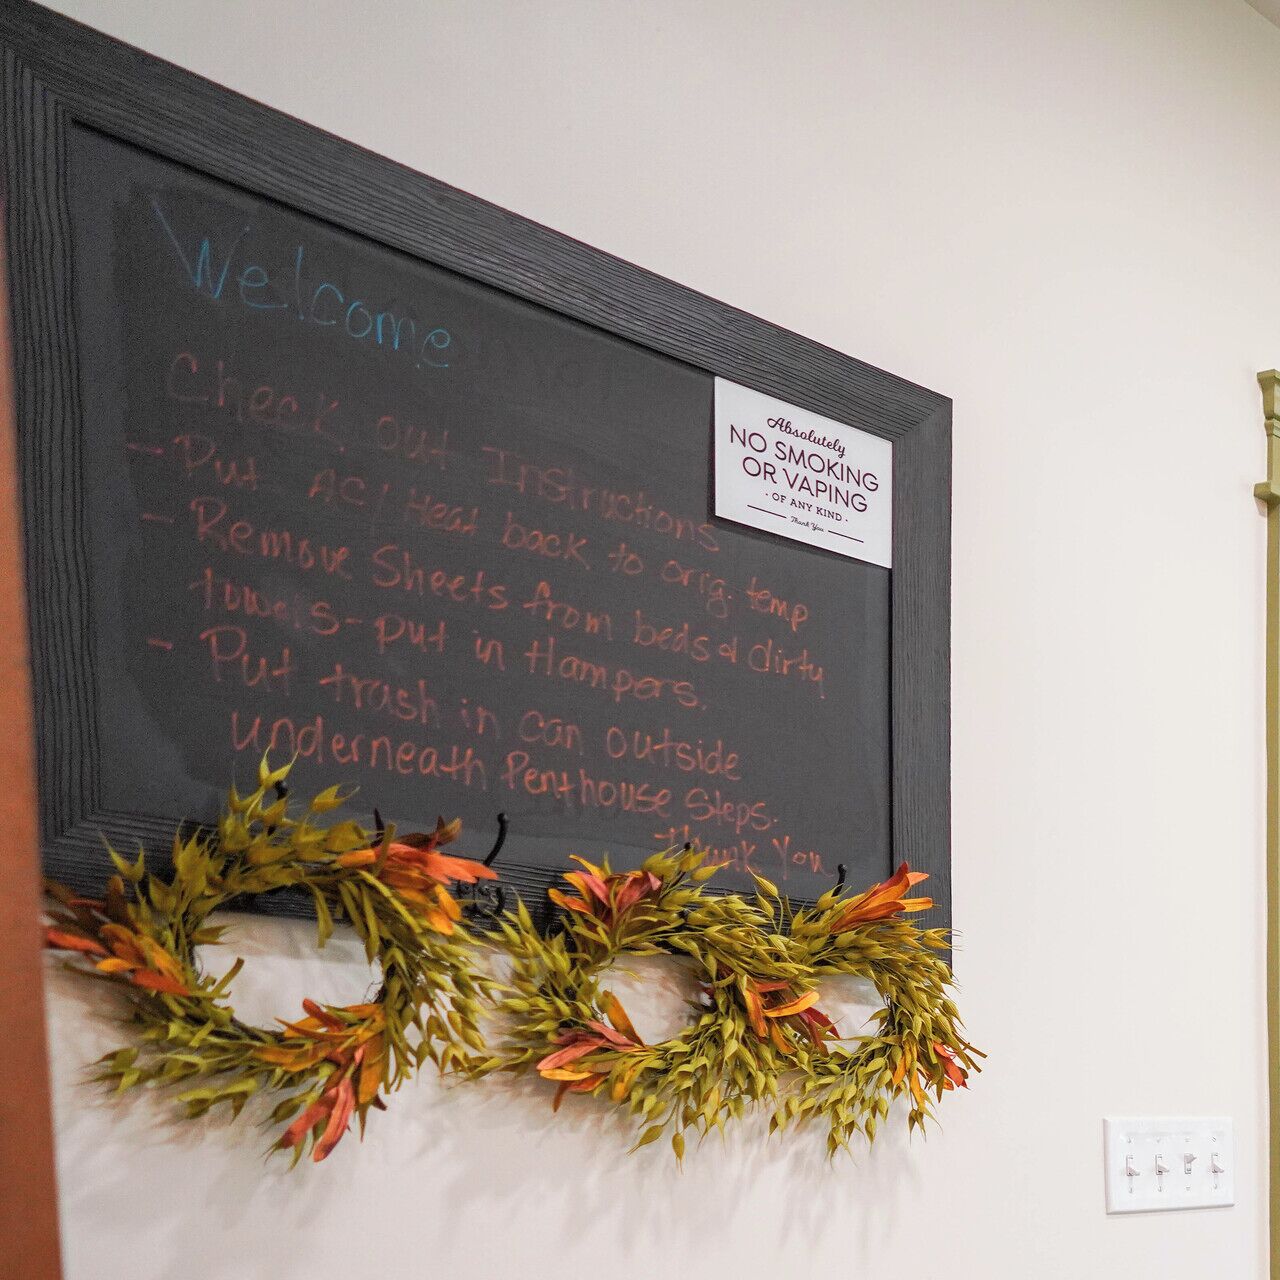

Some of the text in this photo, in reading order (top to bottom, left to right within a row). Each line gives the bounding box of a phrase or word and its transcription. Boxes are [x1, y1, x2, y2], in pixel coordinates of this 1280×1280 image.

[152, 198, 451, 368] Welcome
[730, 424, 879, 492] NO SMOKING
[766, 417, 846, 459] Absolutely
[742, 456, 868, 512] OR VAPING
[772, 492, 842, 522] OF ANY KIND
[791, 515, 810, 528] Thank
[190, 496, 352, 582] Remove
[522, 581, 613, 641] from
[633, 609, 711, 662] beds
[747, 638, 826, 700] dirty
[501, 510, 591, 570] back
[608, 543, 645, 575] to
[746, 577, 810, 633] temp
[472, 628, 505, 672] in
[200, 624, 290, 697] Put
[319, 661, 441, 730] trash
[459, 698, 500, 736] in
[519, 709, 583, 756] can
[771, 834, 837, 882] You
